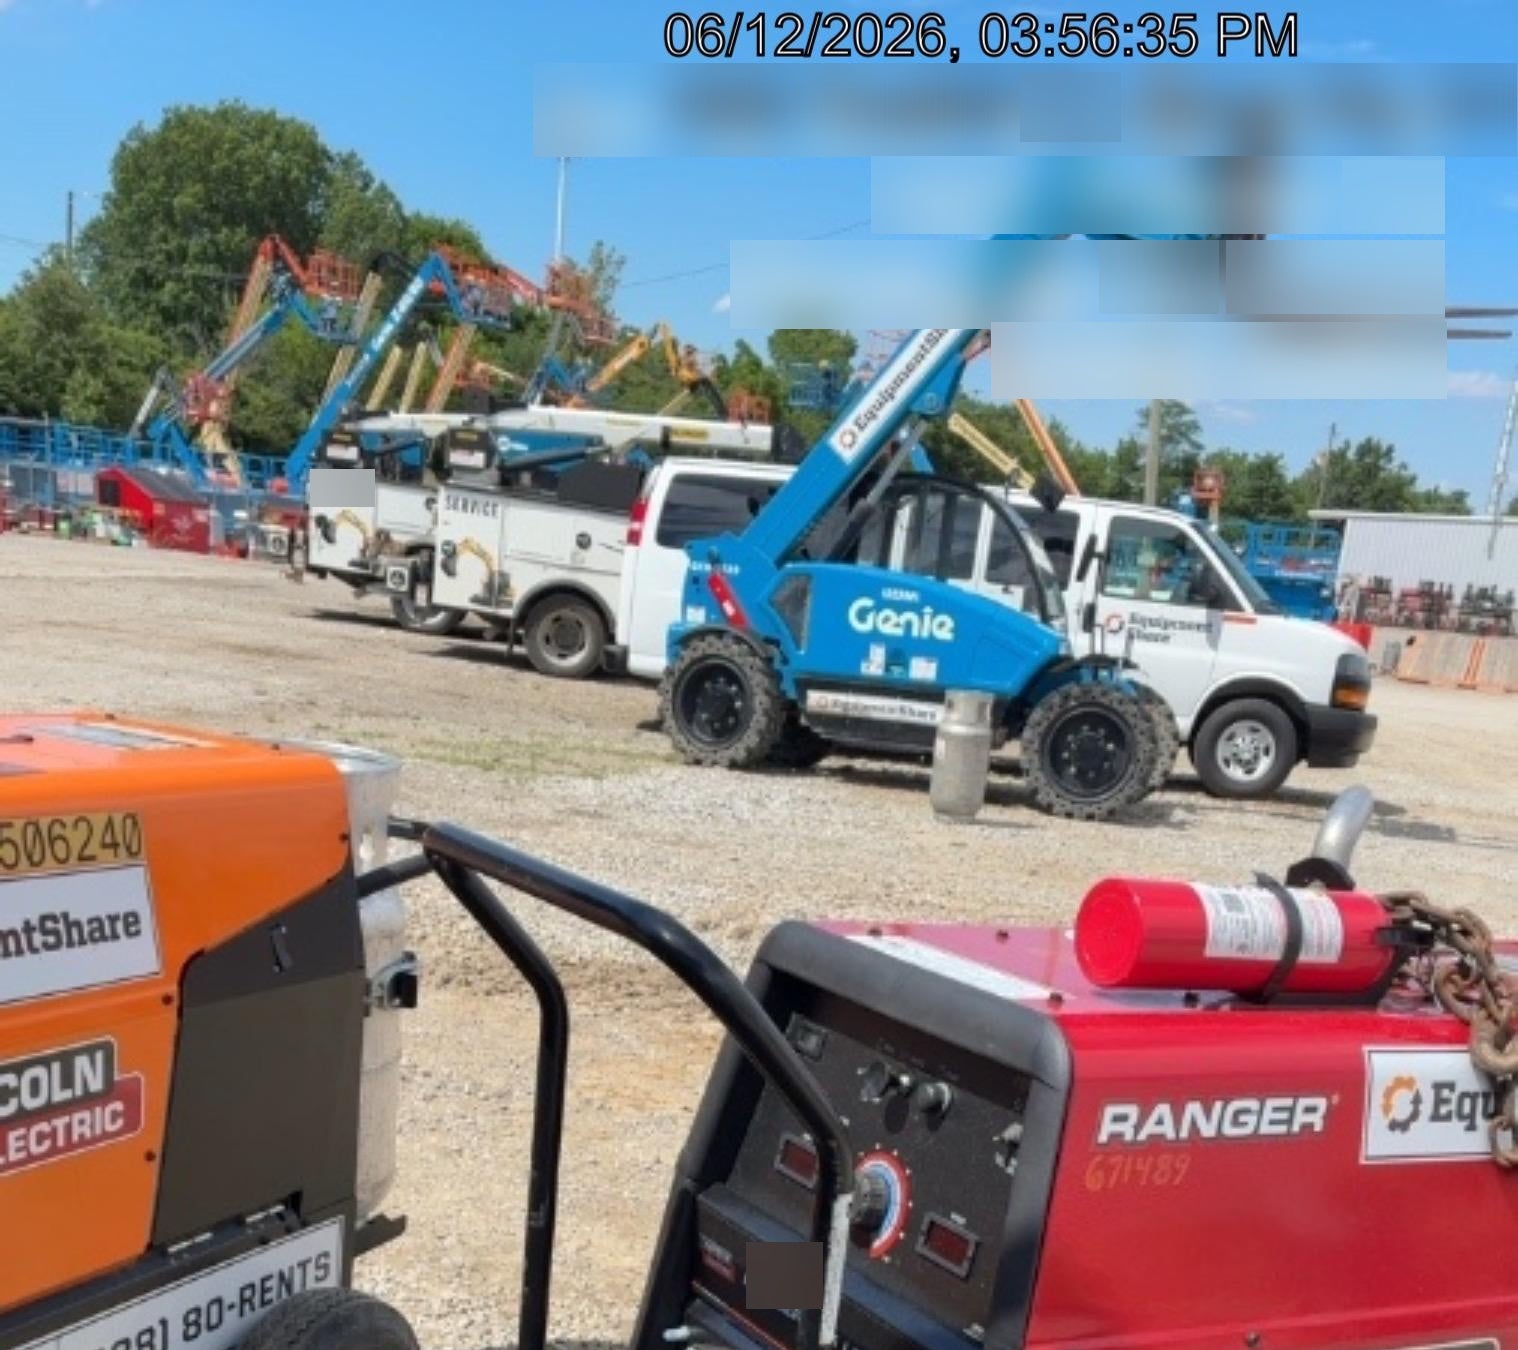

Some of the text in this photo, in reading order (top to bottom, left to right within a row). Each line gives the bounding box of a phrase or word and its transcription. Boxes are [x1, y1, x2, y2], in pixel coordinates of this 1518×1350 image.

[445, 494, 499, 517] SERVICE
[848, 596, 956, 641] Genie
[0, 812, 142, 870] 506240
[0, 910, 142, 959] ntShare
[0, 1100, 125, 1165] ECTRIC
[1097, 1097, 1328, 1143] RANGER
[182, 1250, 332, 1342] 80-RENTS
